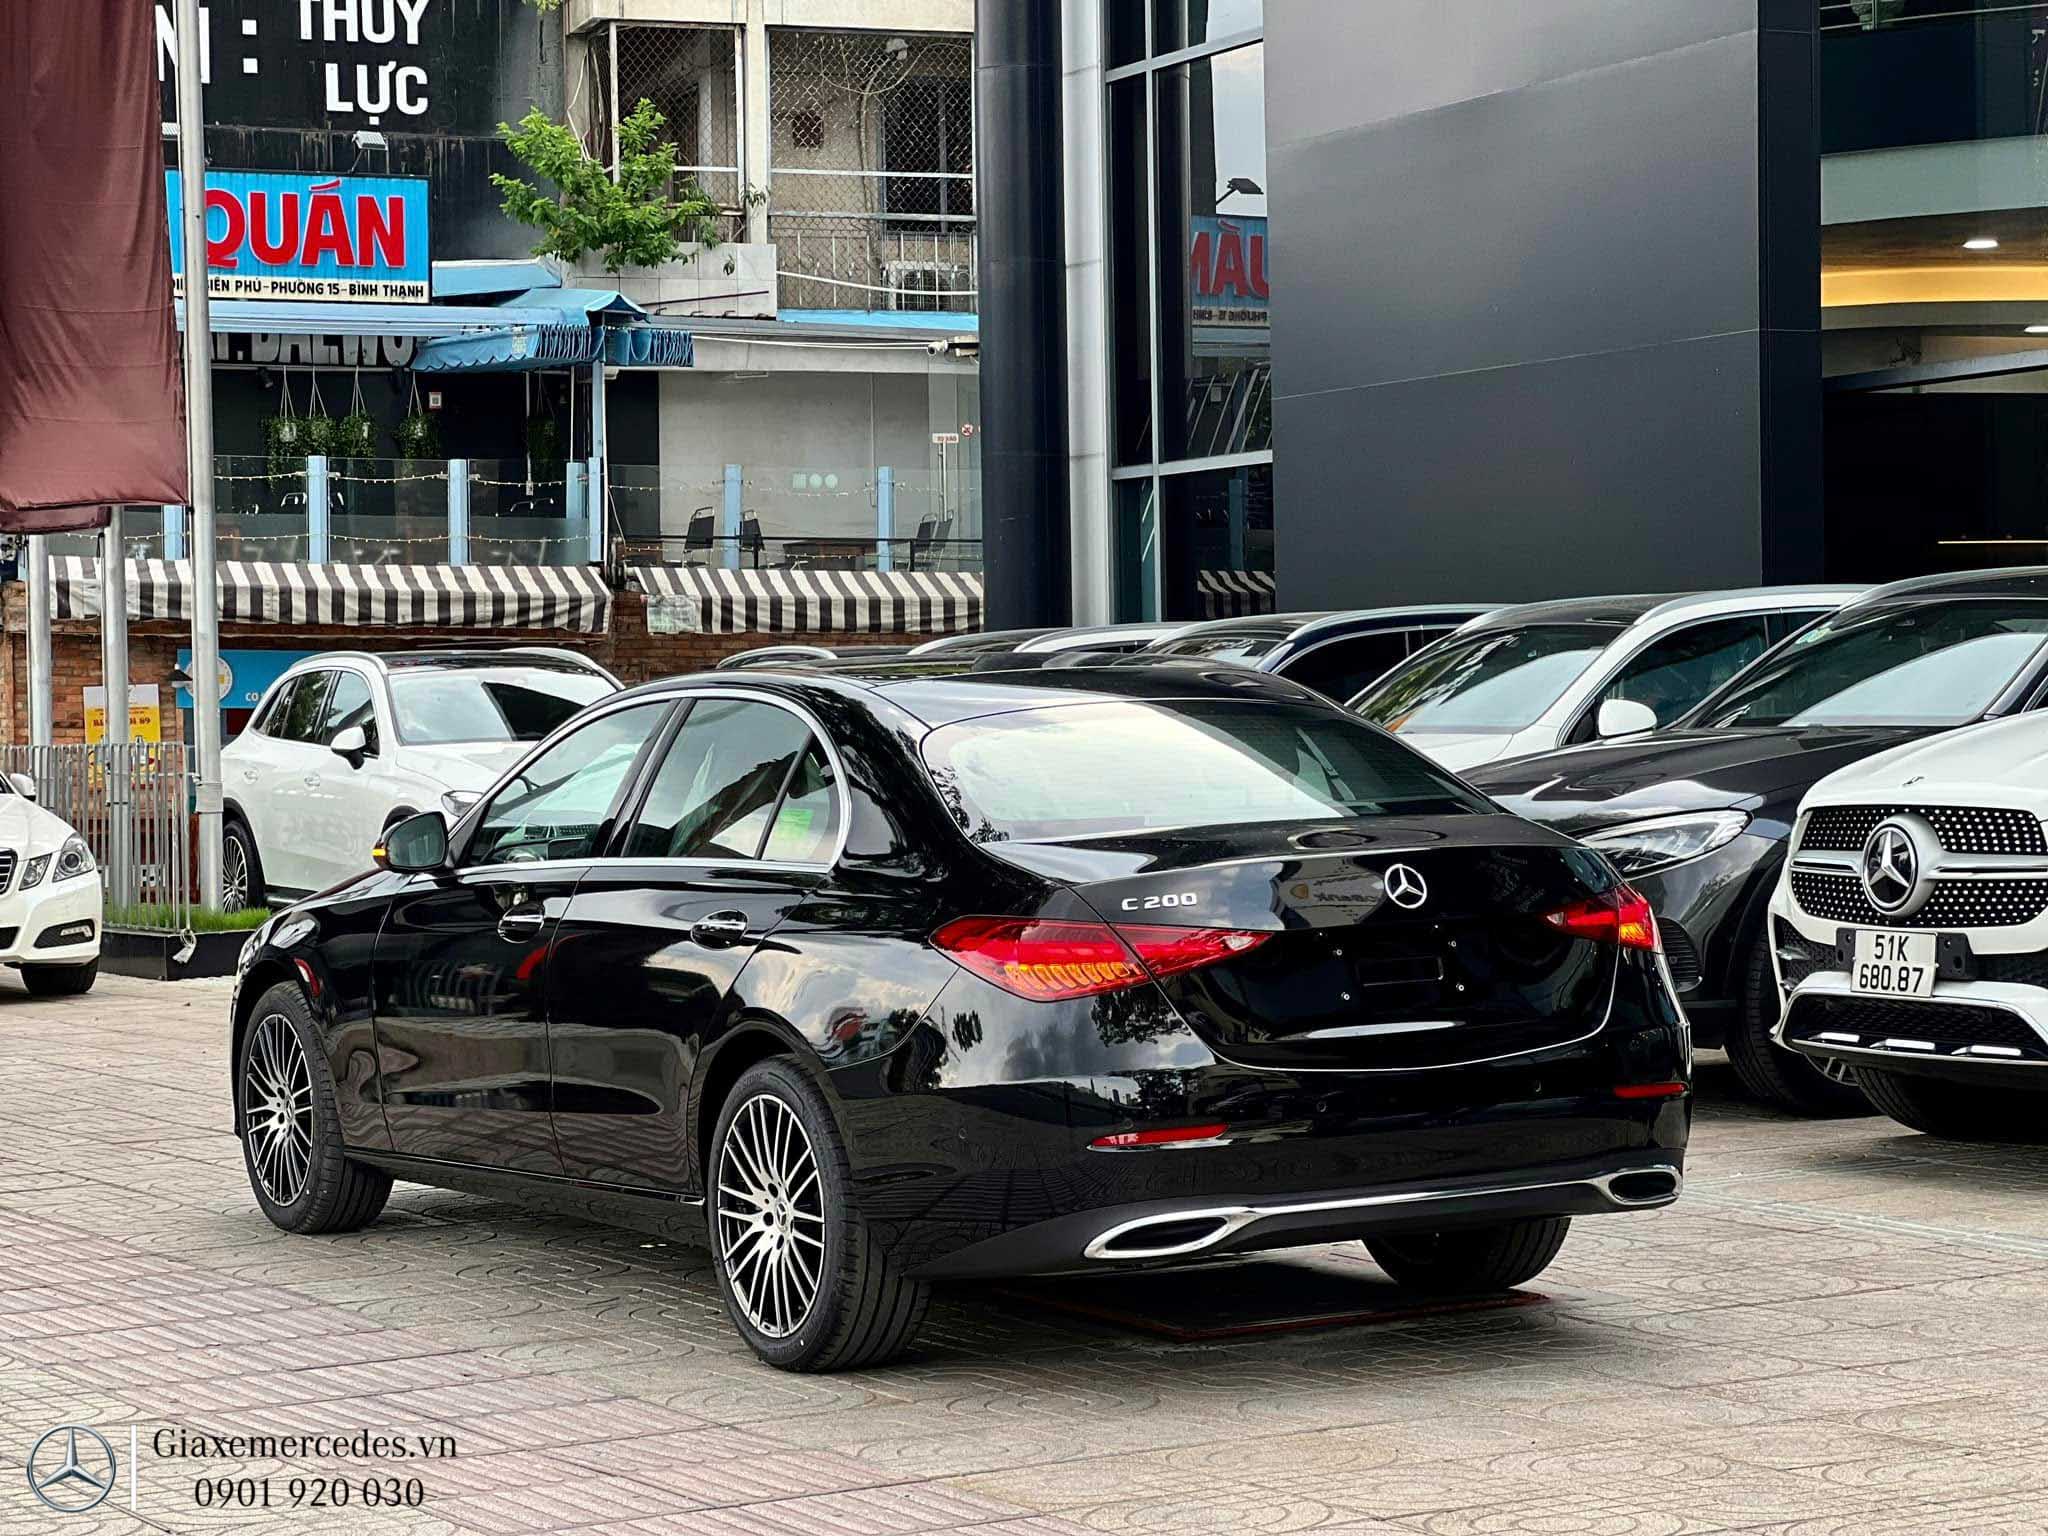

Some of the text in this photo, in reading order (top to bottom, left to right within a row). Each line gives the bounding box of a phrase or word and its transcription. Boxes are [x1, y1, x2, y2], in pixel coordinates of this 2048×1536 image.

[325, 61, 429, 126] LỰC
[205, 179, 405, 269] QUÁN
[208, 276, 230, 292] IÊN
[382, 284, 424, 301] THẠNH
[1121, 892, 1198, 911] C 200
[1874, 934, 1910, 962] 51K
[1859, 963, 1924, 993] 680.87
